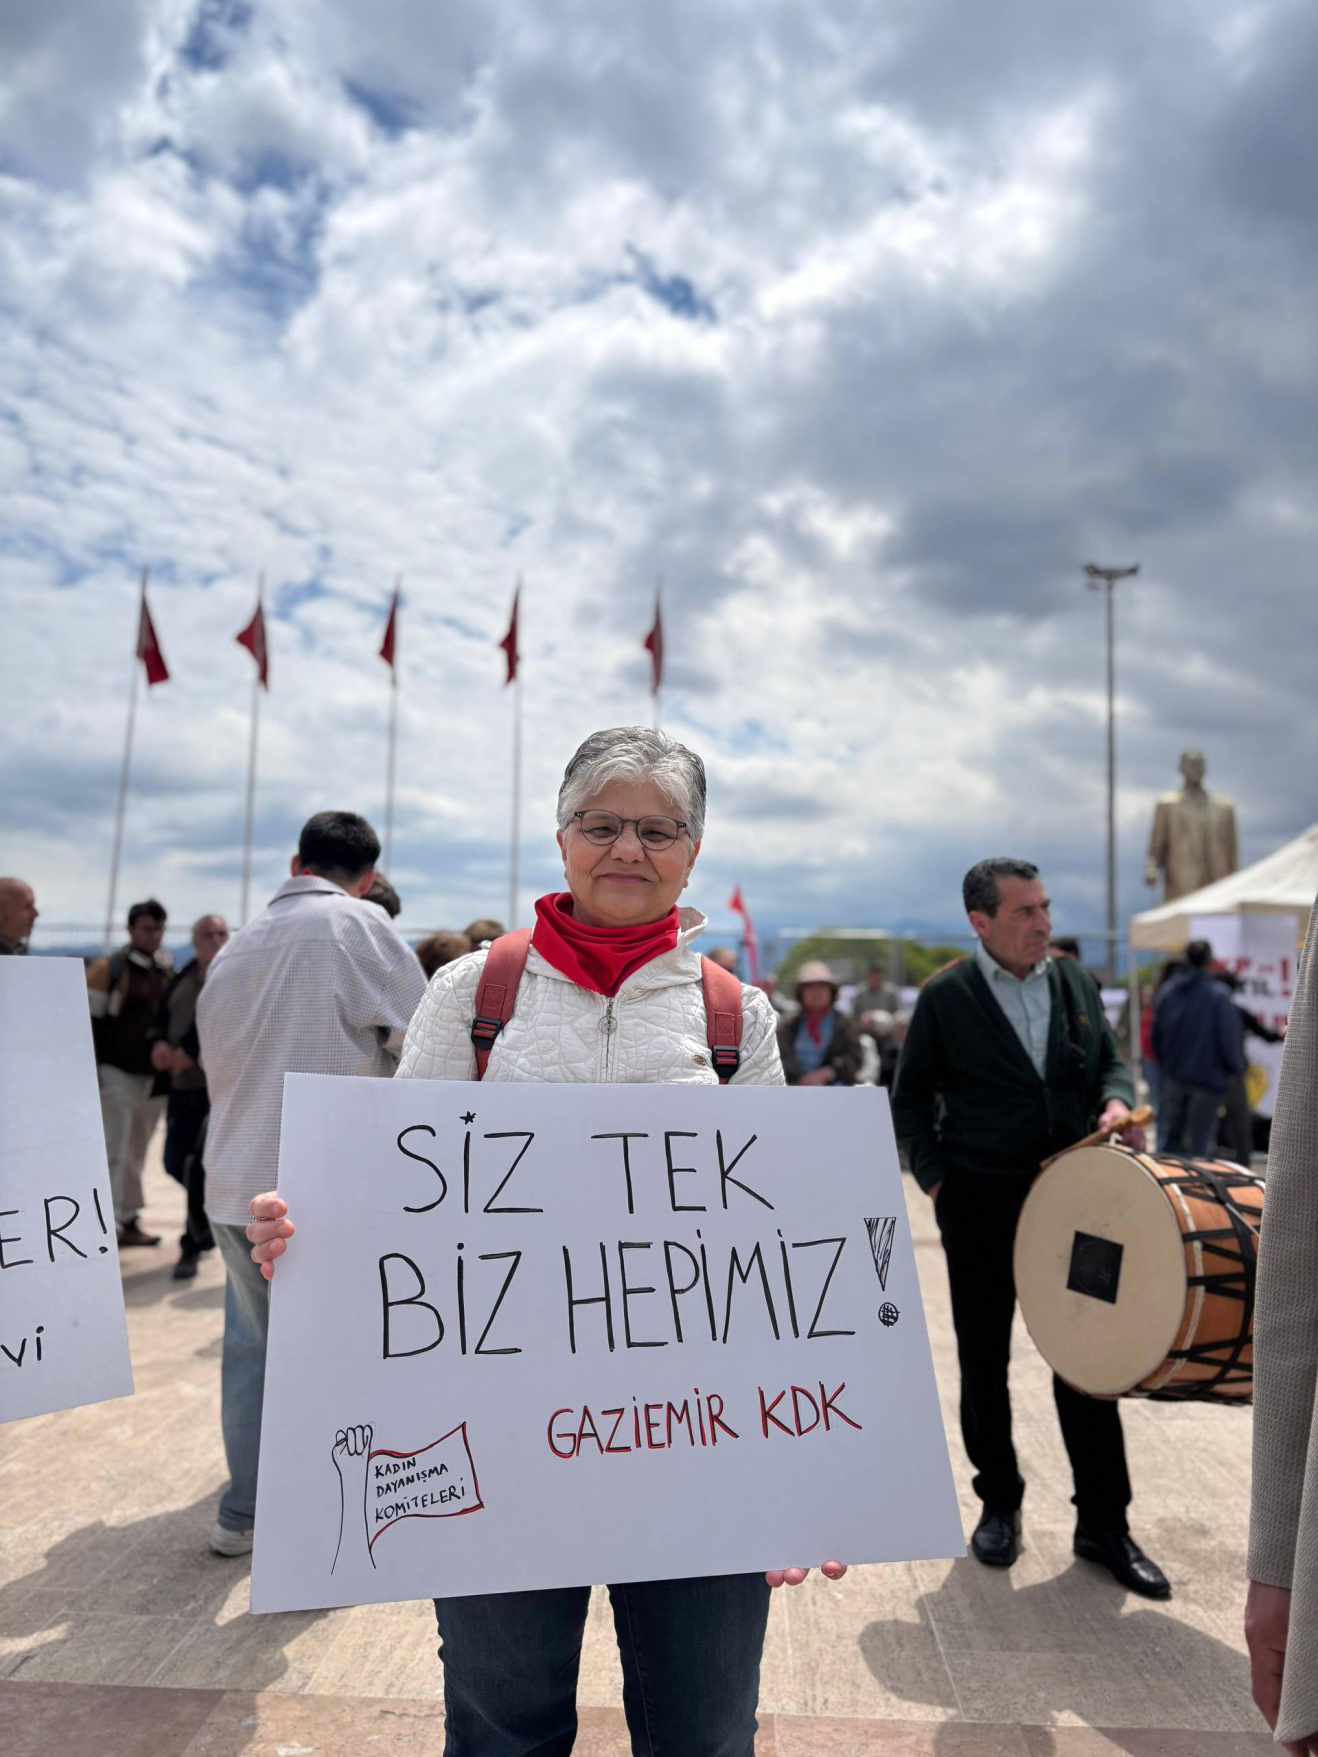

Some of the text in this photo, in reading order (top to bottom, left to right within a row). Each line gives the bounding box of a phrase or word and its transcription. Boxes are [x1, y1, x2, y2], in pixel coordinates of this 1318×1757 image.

[397, 1111, 775, 1214] SİZ TEK
[379, 1242, 523, 1360] BİZ
[547, 1381, 863, 1460] GAZİEMİR KDK
[374, 1457, 417, 1479] KADIN
[375, 1463, 449, 1499] DAYANIŞMA
[375, 1476, 466, 1524] KOMİTELERİ
